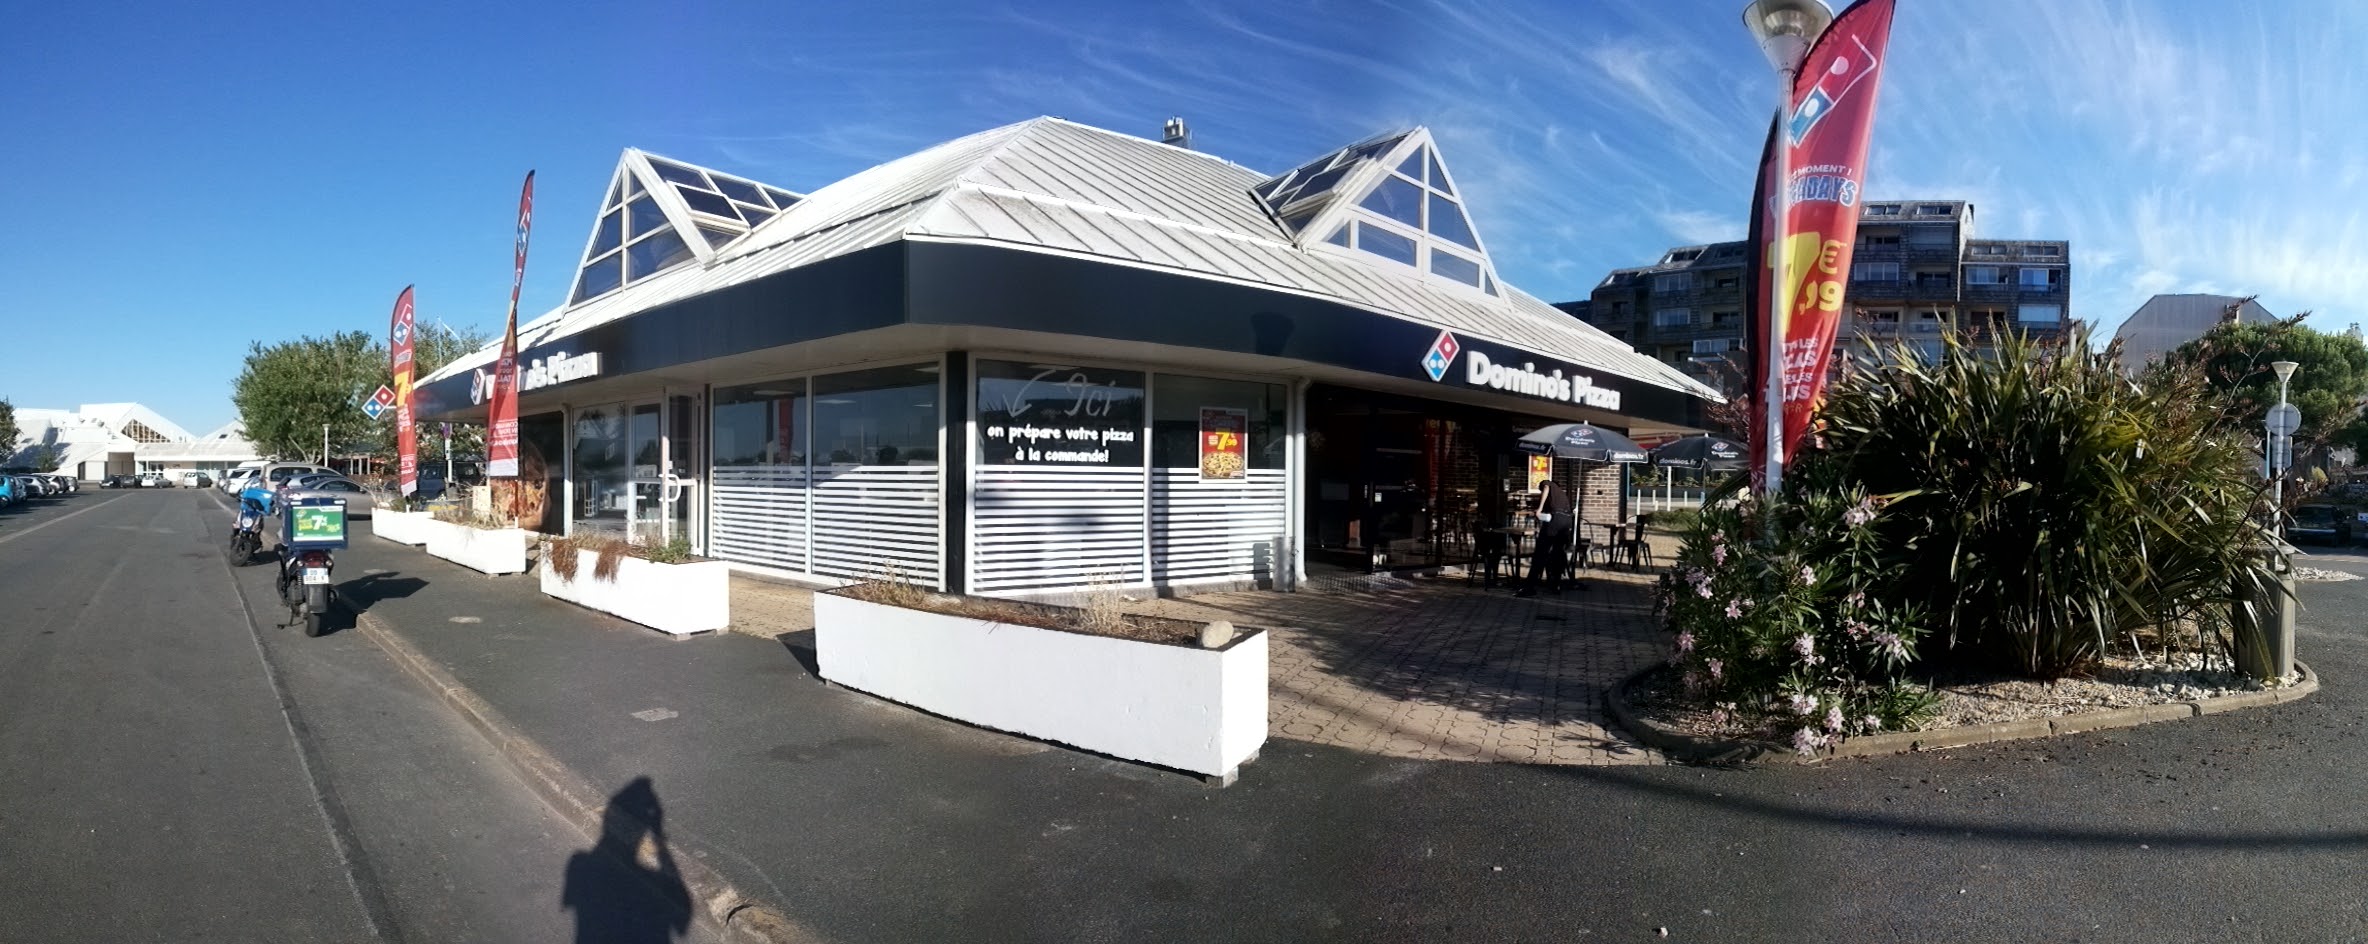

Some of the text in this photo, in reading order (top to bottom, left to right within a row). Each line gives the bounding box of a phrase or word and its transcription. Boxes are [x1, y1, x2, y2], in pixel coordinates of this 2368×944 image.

[1797, 164, 1846, 176] MOMENT
[1466, 350, 1621, 411] Domino's Pizza
[1064, 372, 1116, 416] Ici
[987, 423, 1135, 447] on prépare votre pizza
[1015, 446, 1110, 463] à la commande!
